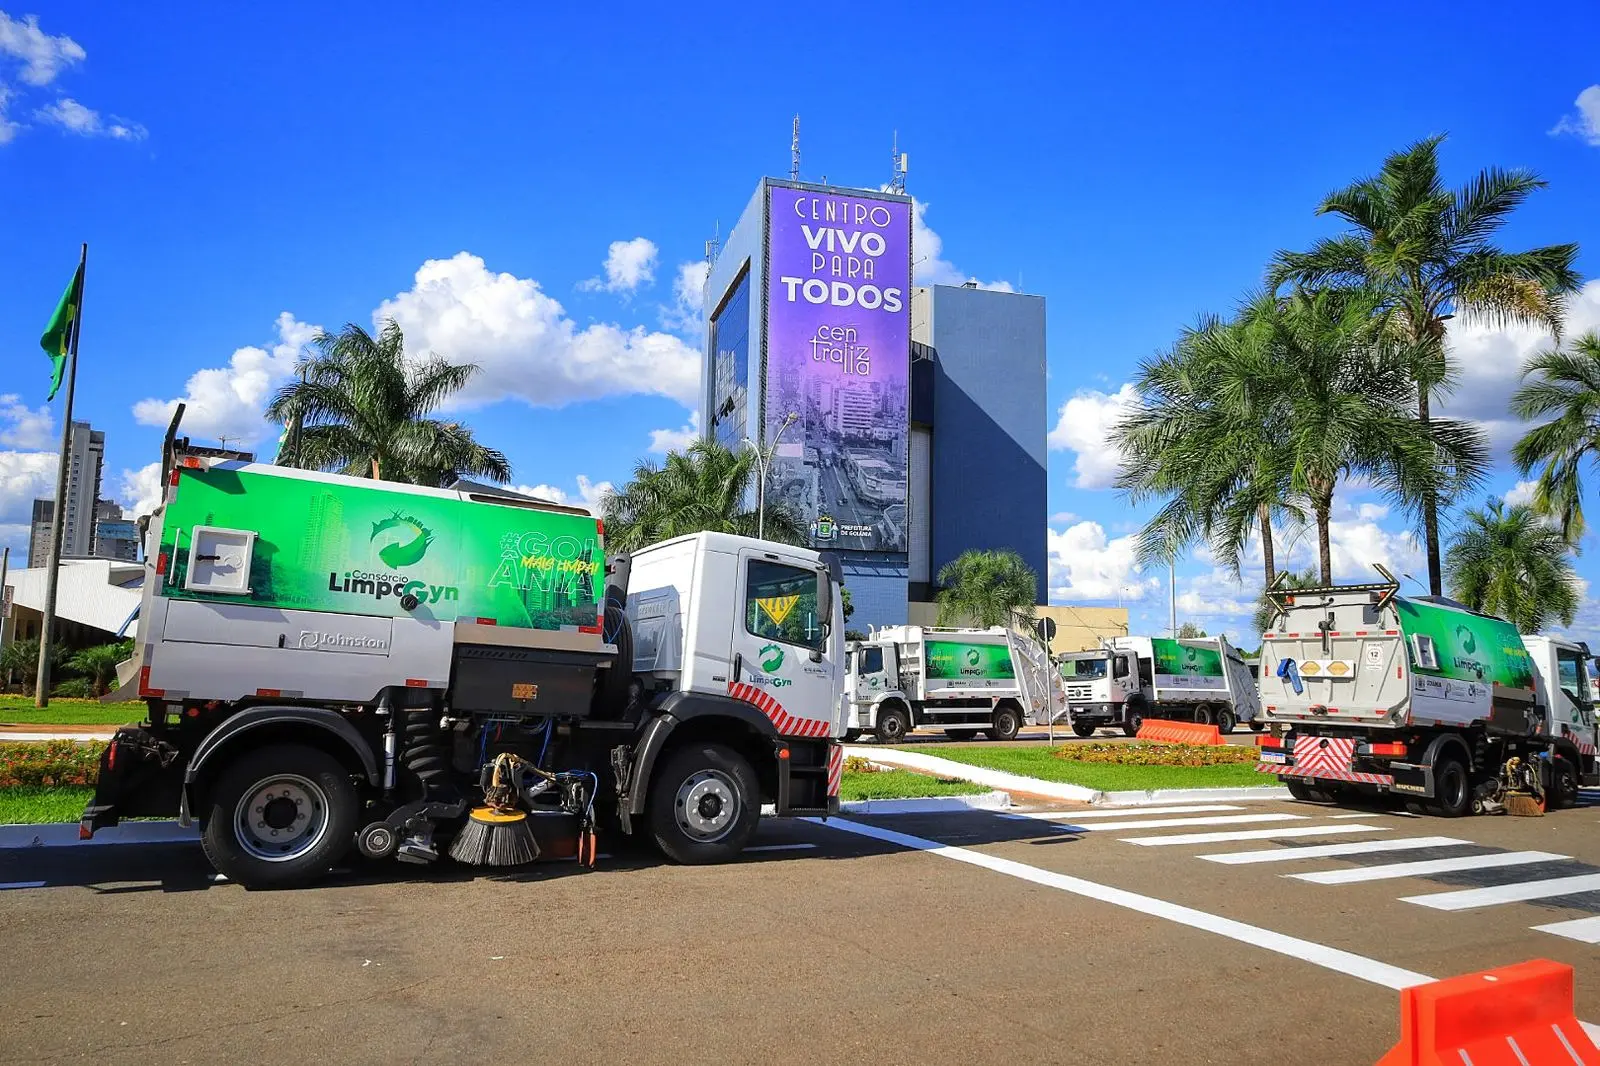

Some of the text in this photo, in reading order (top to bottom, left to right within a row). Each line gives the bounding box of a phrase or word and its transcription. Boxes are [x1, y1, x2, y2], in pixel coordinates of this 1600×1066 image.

[794, 197, 891, 227] CENTRO
[801, 224, 886, 257] VIVO
[812, 252, 875, 280] PARA
[780, 276, 903, 313] TODOS
[818, 325, 857, 343] cen
[840, 524, 872, 532] PREFEITURA
[352, 569, 409, 583] Consórcio
[321, 632, 389, 649] Johnston
[749, 674, 792, 687] LimpaGyn
